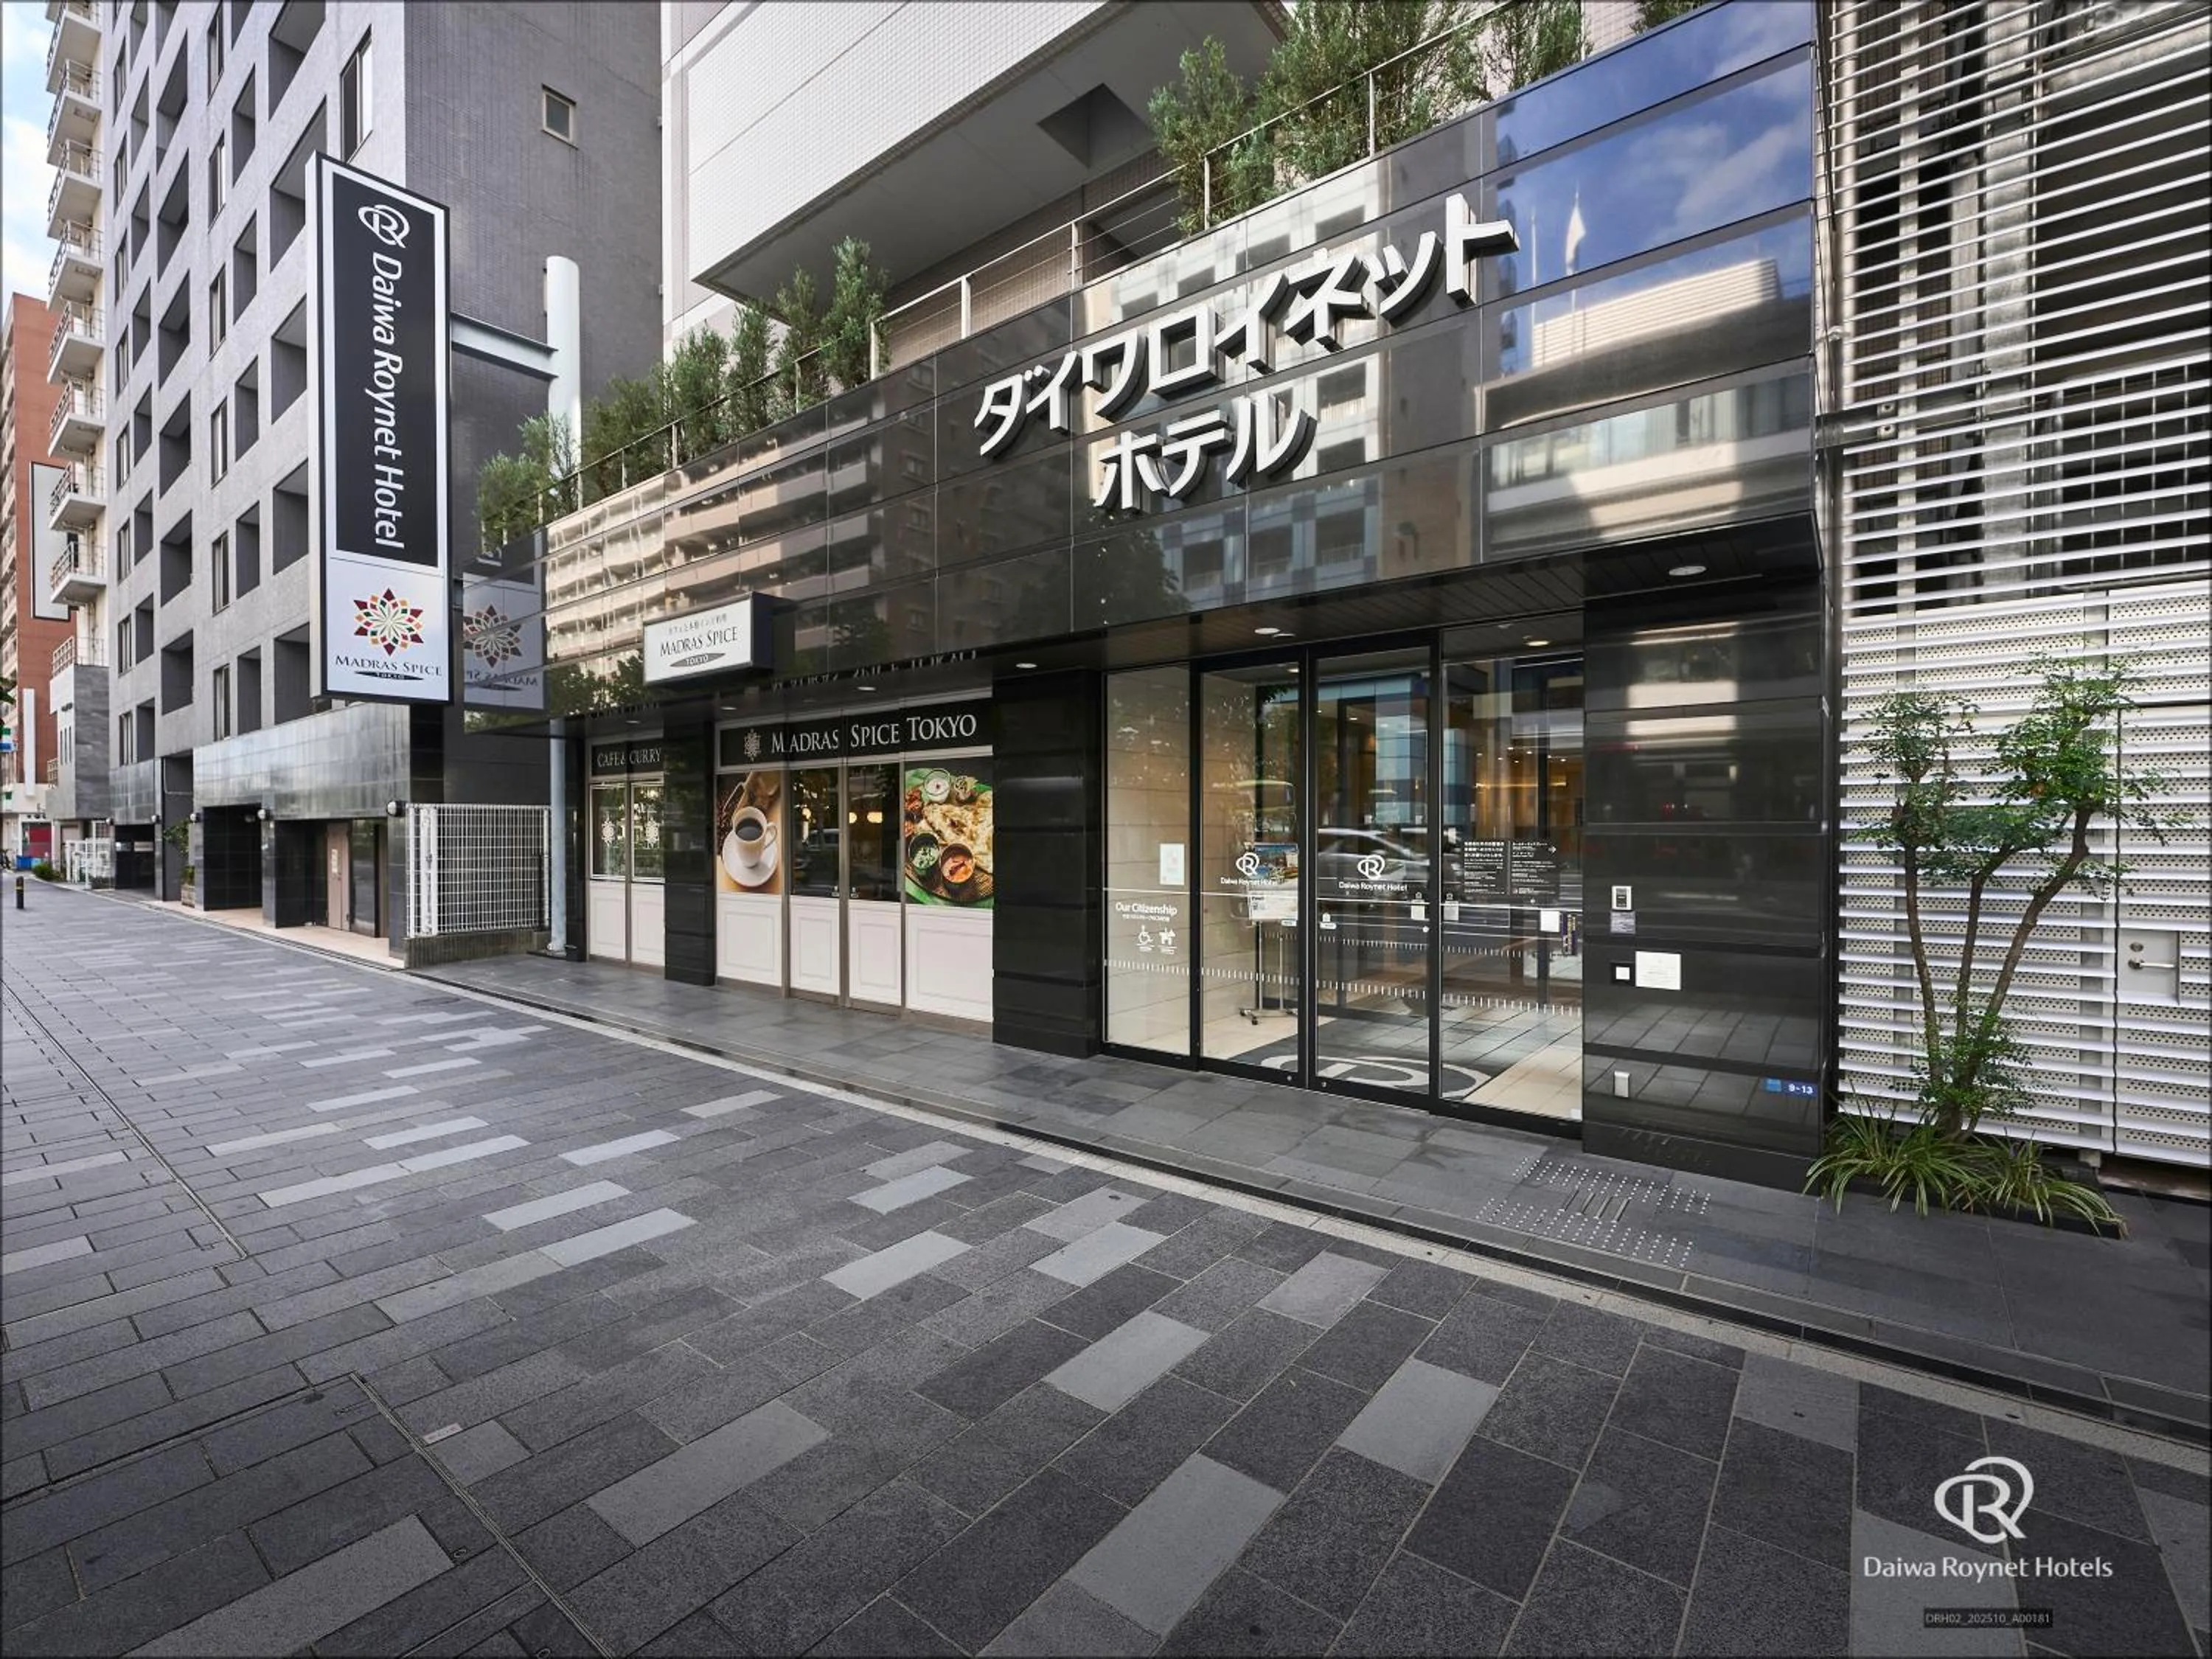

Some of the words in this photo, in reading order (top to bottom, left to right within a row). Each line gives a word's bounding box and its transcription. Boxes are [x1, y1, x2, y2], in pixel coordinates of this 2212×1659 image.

[372, 251, 403, 345] Daiwa
[973, 193, 1519, 459] ダイワロイネット
[364, 348, 403, 461] Roynet
[1093, 392, 1317, 510] ホテル
[374, 464, 405, 549] Hotel
[660, 636, 703, 658] MADRAS
[707, 626, 738, 647] SPICE
[685, 653, 709, 666] TOKYO
[335, 655, 397, 671] MADRAS
[402, 661, 442, 677] SPICE
[771, 729, 838, 754] MADRAS
[850, 723, 900, 748] SPICE
[907, 714, 977, 741] TOKYO
[629, 747, 661, 765] CURRY
[1116, 902, 1130, 912] Our
[1132, 902, 1178, 917] Citizenship
